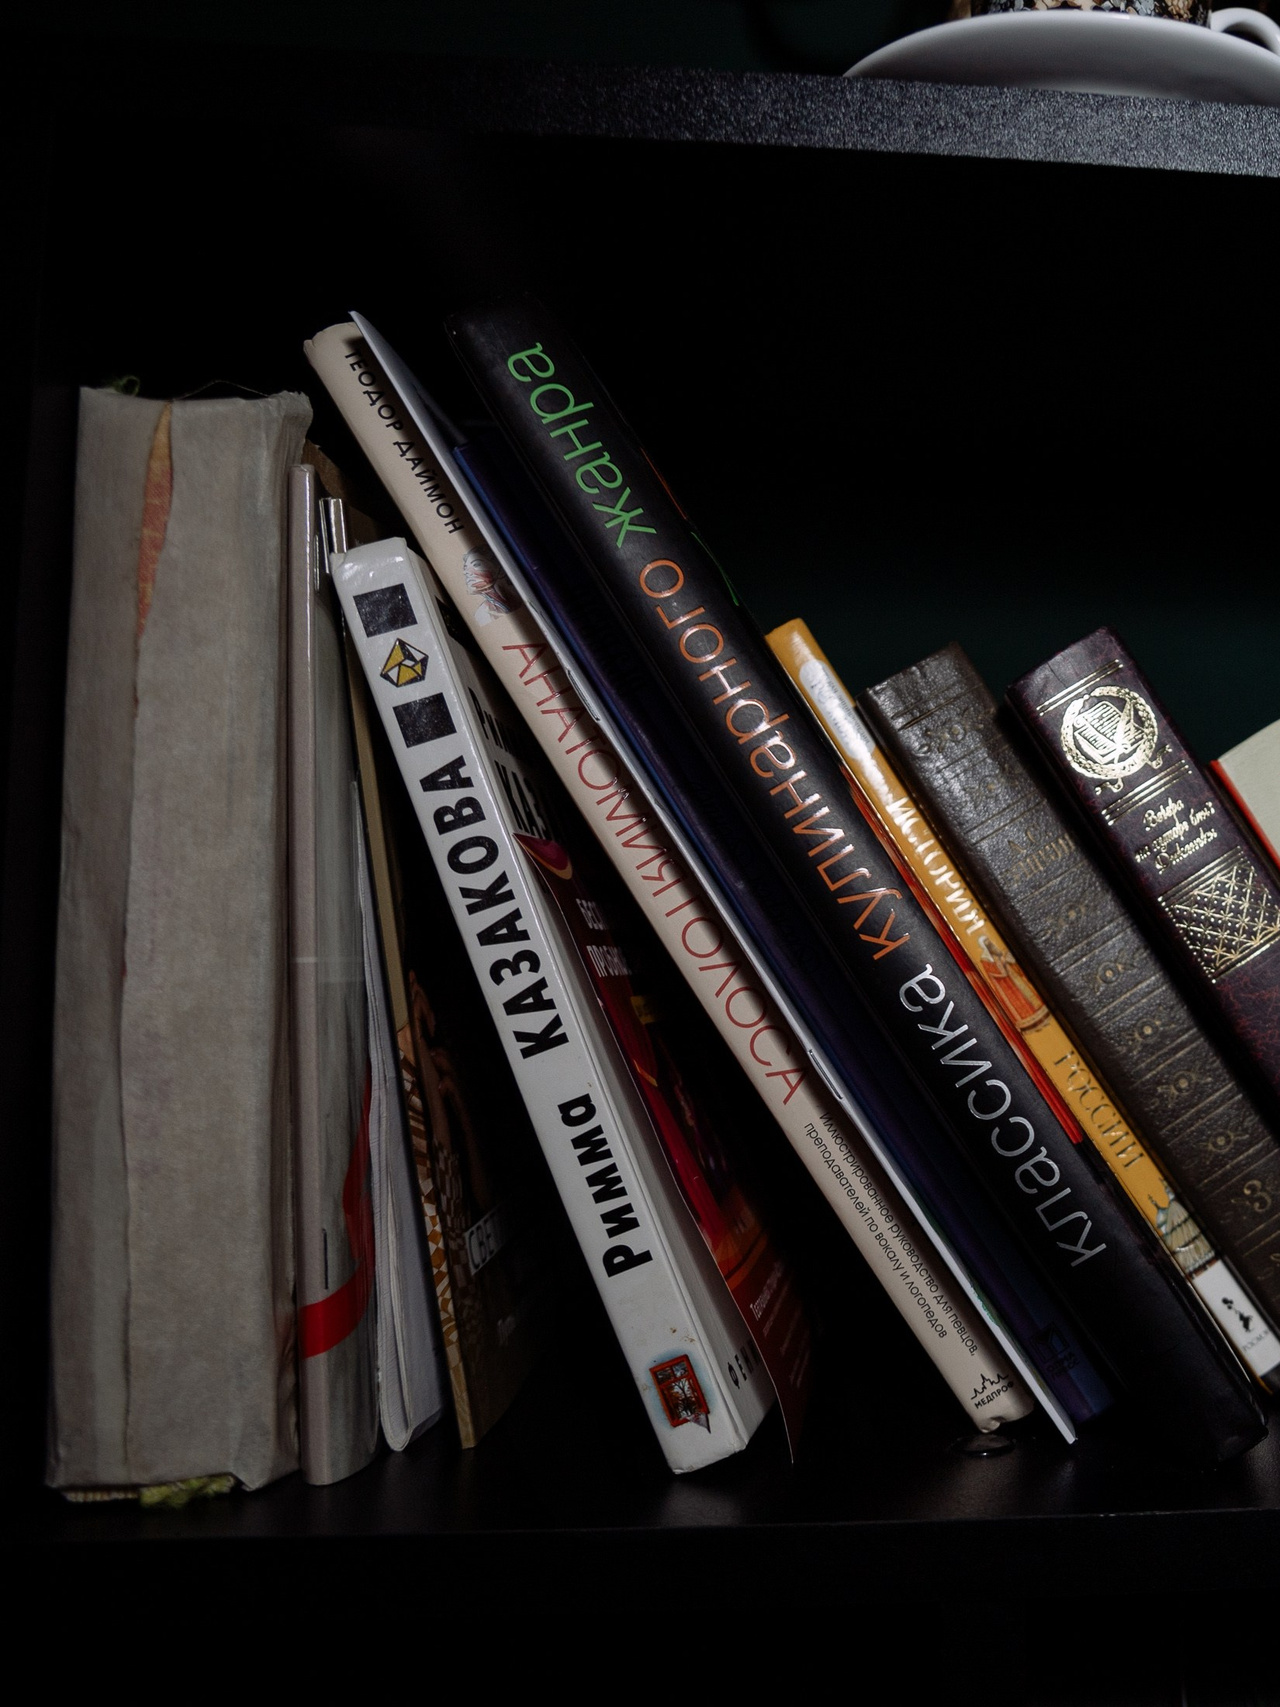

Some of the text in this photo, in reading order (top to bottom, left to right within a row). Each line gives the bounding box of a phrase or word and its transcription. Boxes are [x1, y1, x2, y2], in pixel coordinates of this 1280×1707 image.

[345, 350, 465, 534] ТЕОДОР ДАЙМОН
[419, 755, 570, 1060] КАЗАКОВА
[502, 642, 809, 1104] АНАТОМИЯ ГОЛОСА
[506, 341, 1107, 1268] классика кулинарного жанра
[557, 1093, 653, 1278] Римма
[804, 1122, 870, 1221] преподавателей
[874, 1229, 904, 1273] вокалу
[905, 1276, 948, 1339] логопедов
[820, 1111, 979, 1357] Иллюстрированное руководство для певцов,
[1242, 1179, 1272, 1213] 3
[974, 1380, 1015, 1410] МЕДПРОФ
